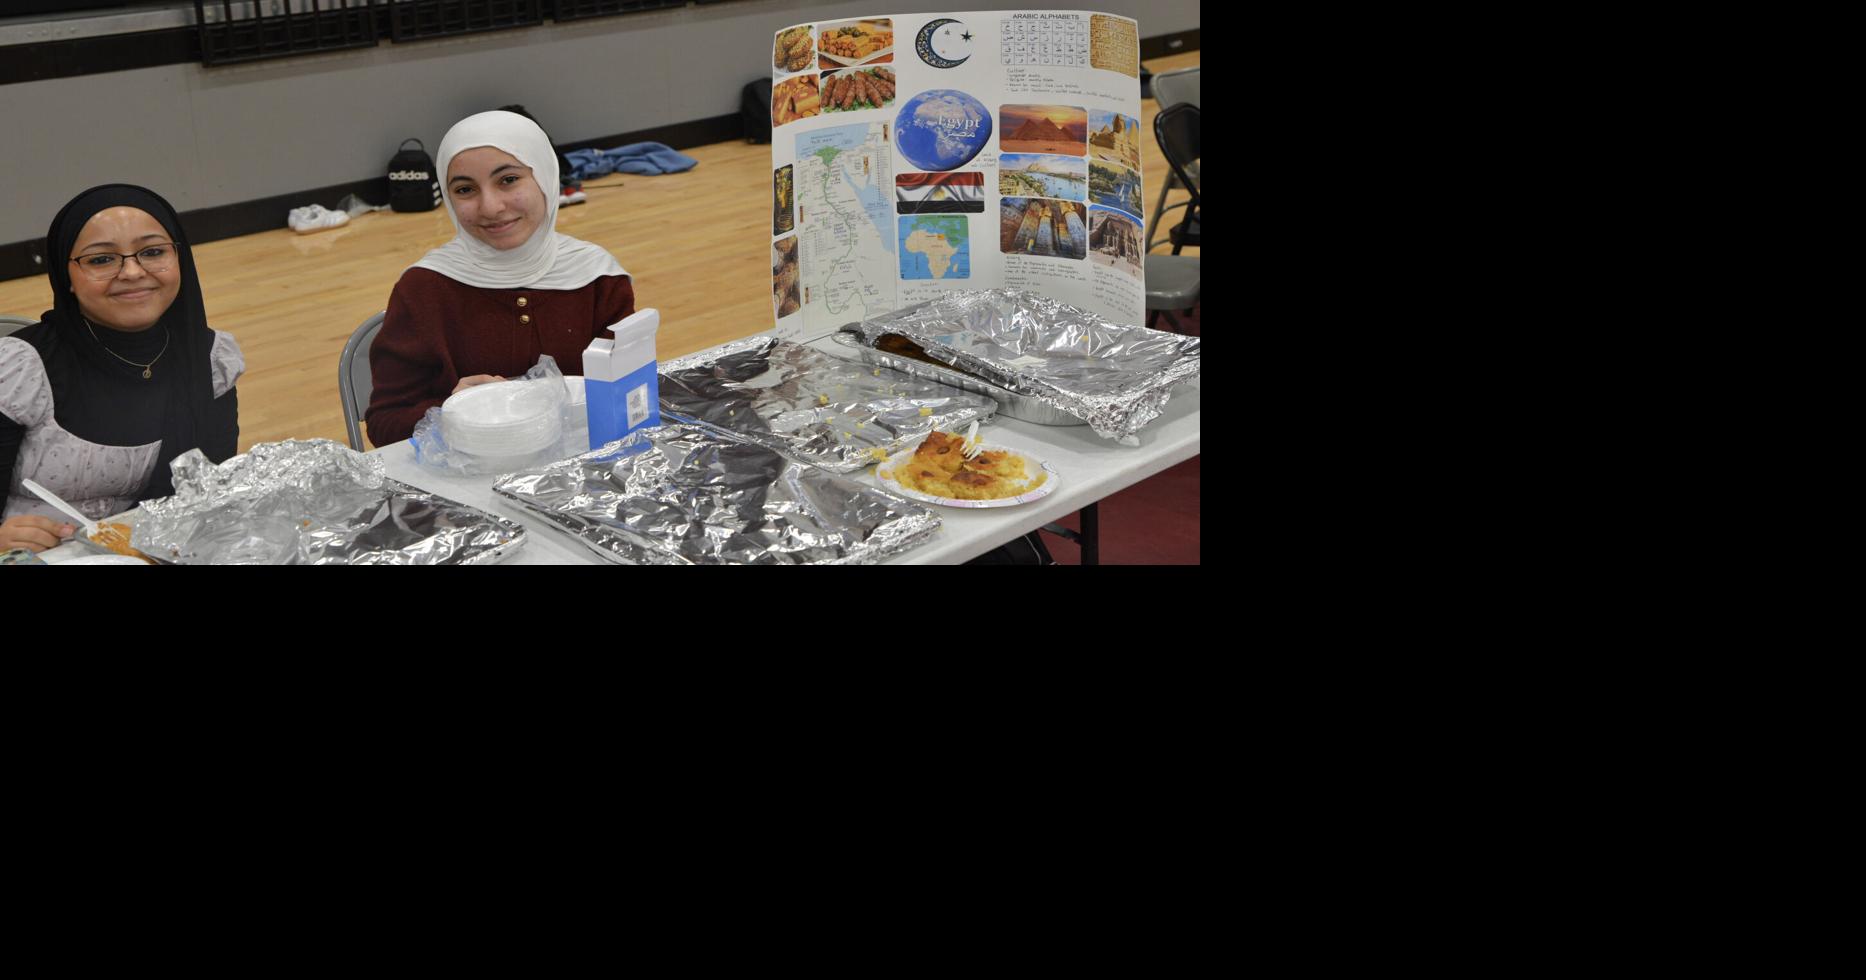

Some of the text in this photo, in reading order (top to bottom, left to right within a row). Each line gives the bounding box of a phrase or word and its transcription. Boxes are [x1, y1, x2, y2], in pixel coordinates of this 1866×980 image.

[939, 114, 981, 130] Egypt
[944, 131, 976, 140] مصر
[388, 169, 430, 181] adidas
